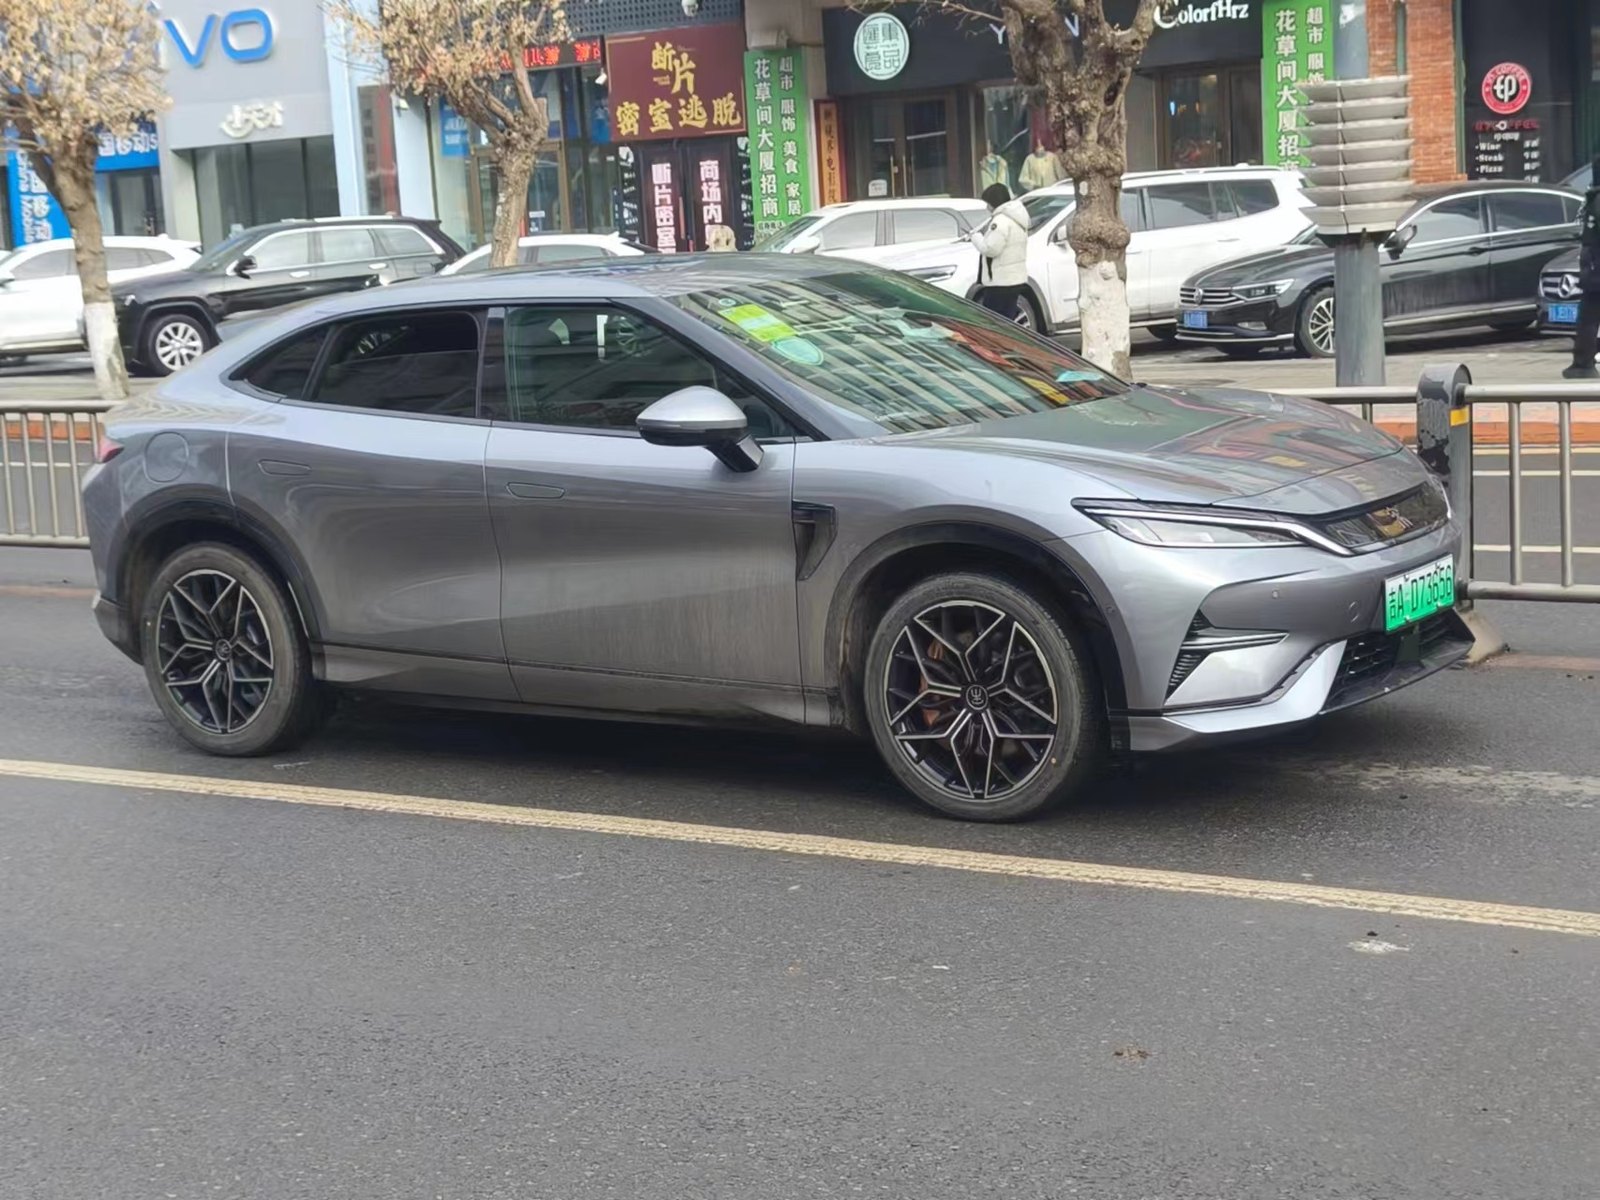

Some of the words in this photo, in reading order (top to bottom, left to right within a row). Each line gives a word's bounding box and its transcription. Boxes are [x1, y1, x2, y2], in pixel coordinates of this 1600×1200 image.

[1306, 7, 1324, 44] 超市
[779, 56, 794, 91] 超市
[616, 92, 741, 136] 密室逃脱
[781, 99, 796, 132] 服饰
[754, 58, 780, 217] 花草间大厦招商
[783, 141, 798, 174] 美食
[786, 182, 801, 216] 家居
